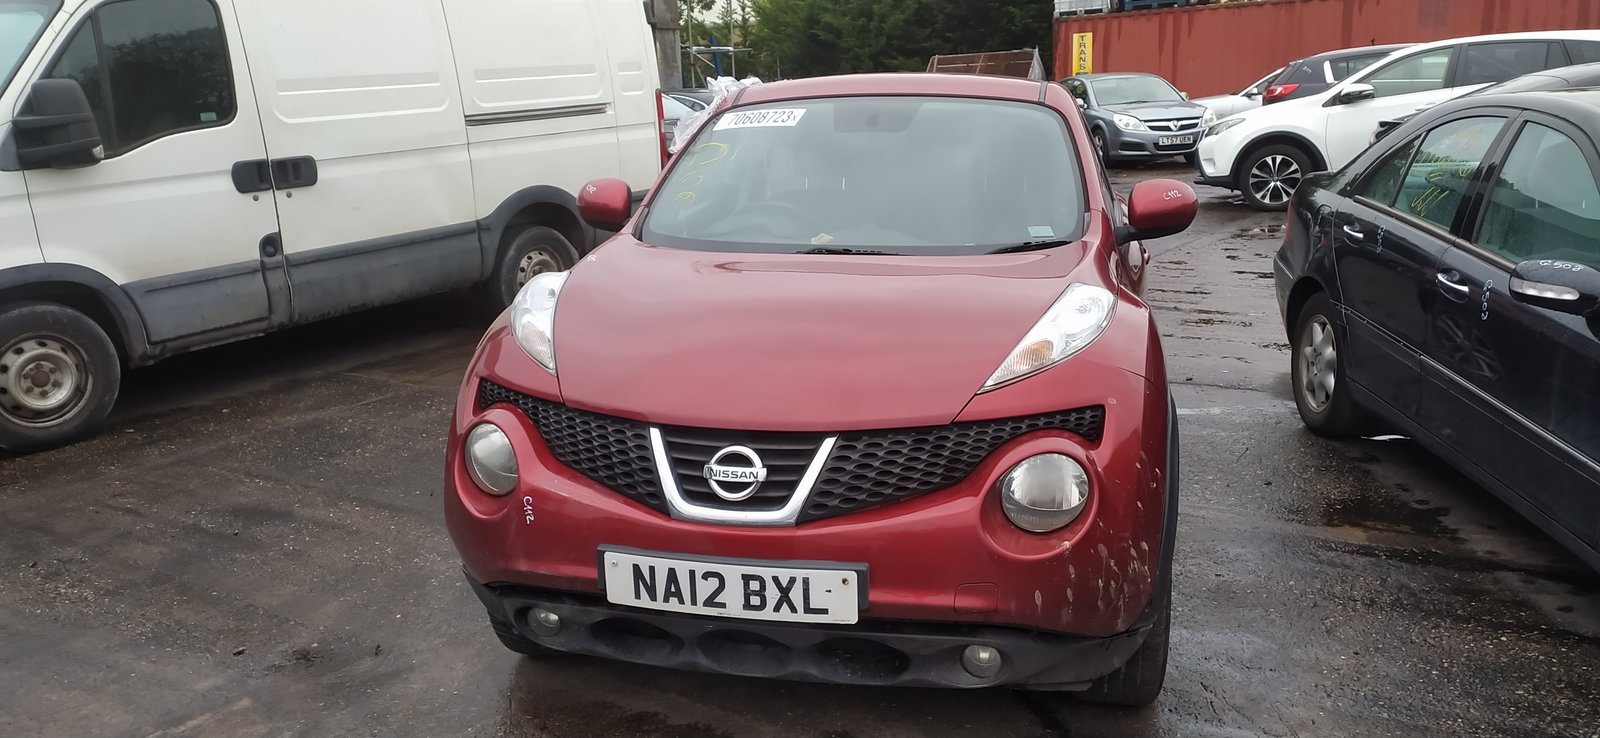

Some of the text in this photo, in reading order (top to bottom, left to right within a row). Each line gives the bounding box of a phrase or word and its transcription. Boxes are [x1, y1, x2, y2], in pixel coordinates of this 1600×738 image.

[1161, 136, 1178, 144] LT57
[1162, 189, 1183, 201] C112
[709, 467, 760, 481] NISSAN
[522, 495, 535, 525] C112
[631, 562, 829, 616] NA12 BXL
